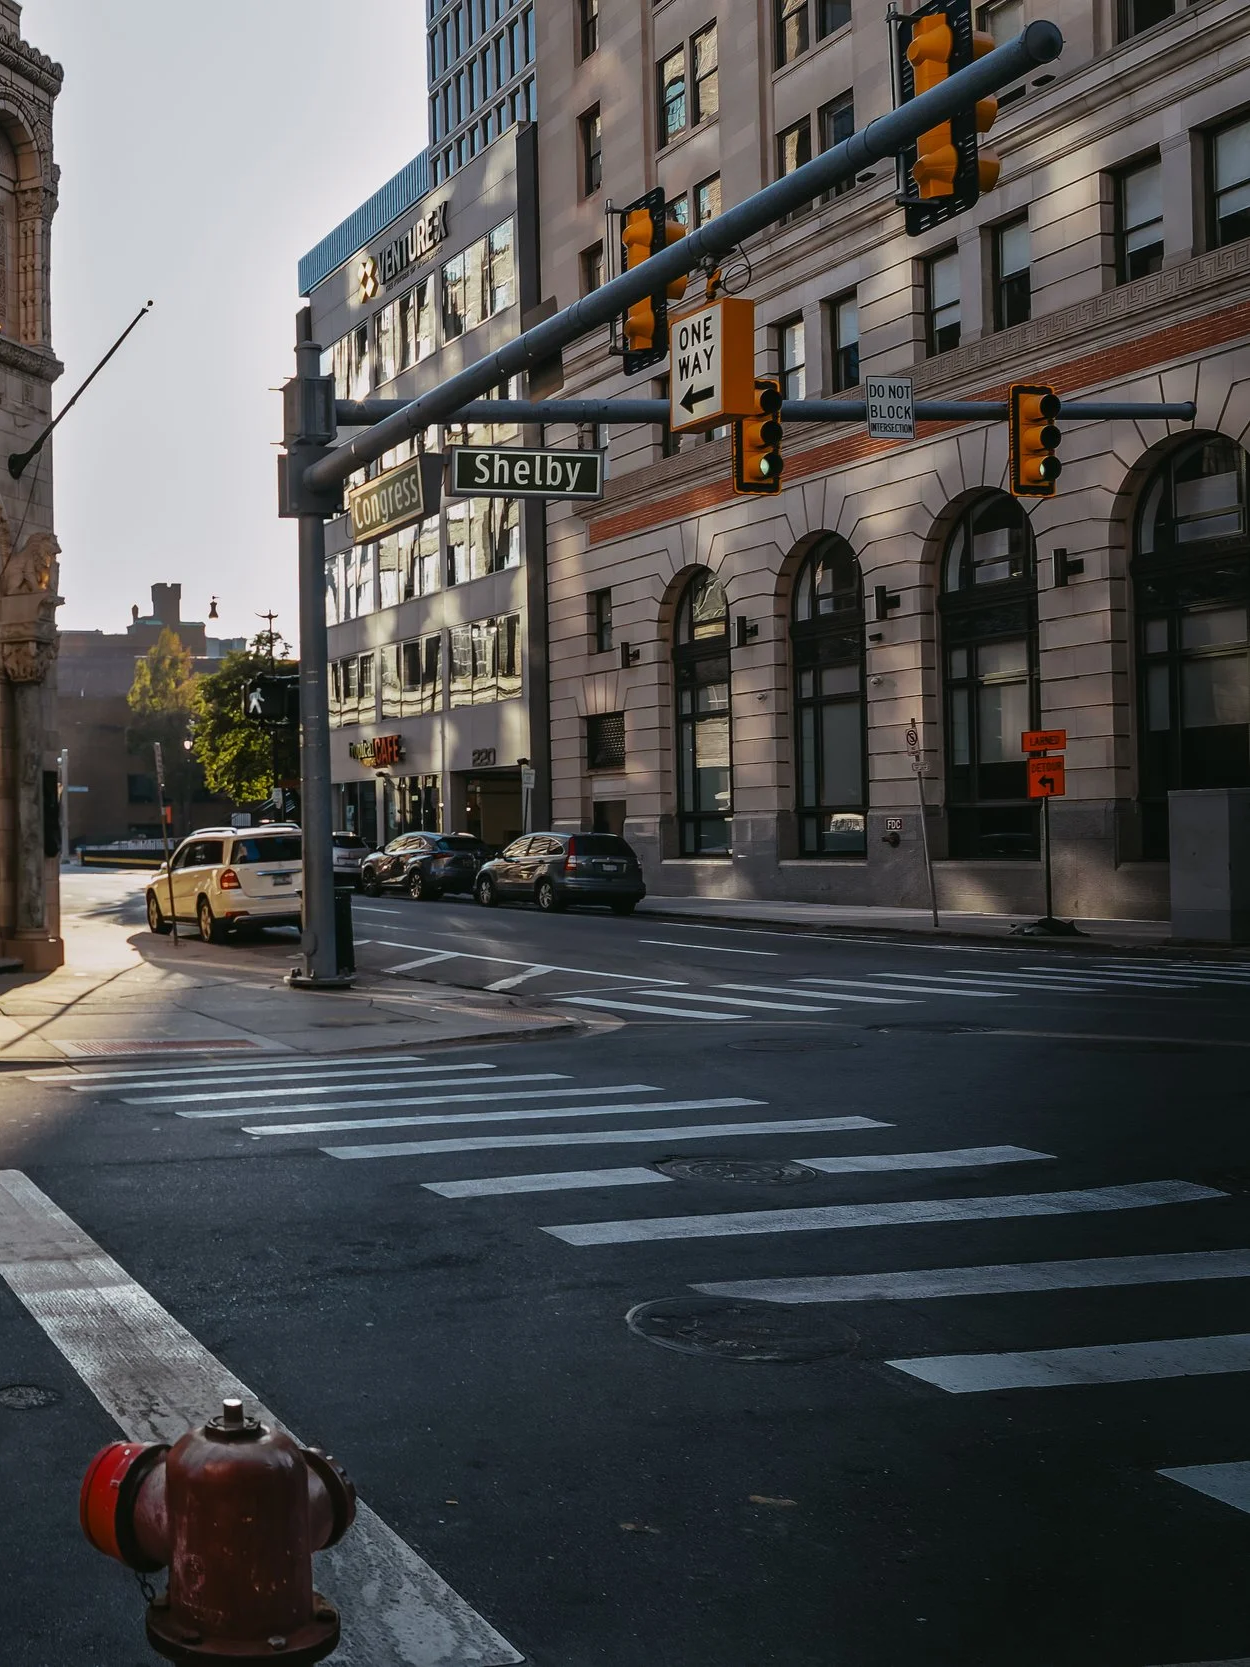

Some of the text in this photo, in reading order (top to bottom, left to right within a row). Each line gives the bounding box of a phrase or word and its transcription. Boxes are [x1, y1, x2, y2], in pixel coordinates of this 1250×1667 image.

[679, 315, 713, 351] ONE
[678, 344, 715, 382] WAY
[869, 384, 911, 399] DO NOT
[870, 405, 912, 420] BLOCK
[870, 422, 913, 433] INTERSECTION
[474, 454, 582, 491] Shelby
[354, 472, 419, 529] Congress
[373, 735, 400, 767] CAFE
[472, 748, 496, 767] 220
[887, 820, 901, 829] FDC
